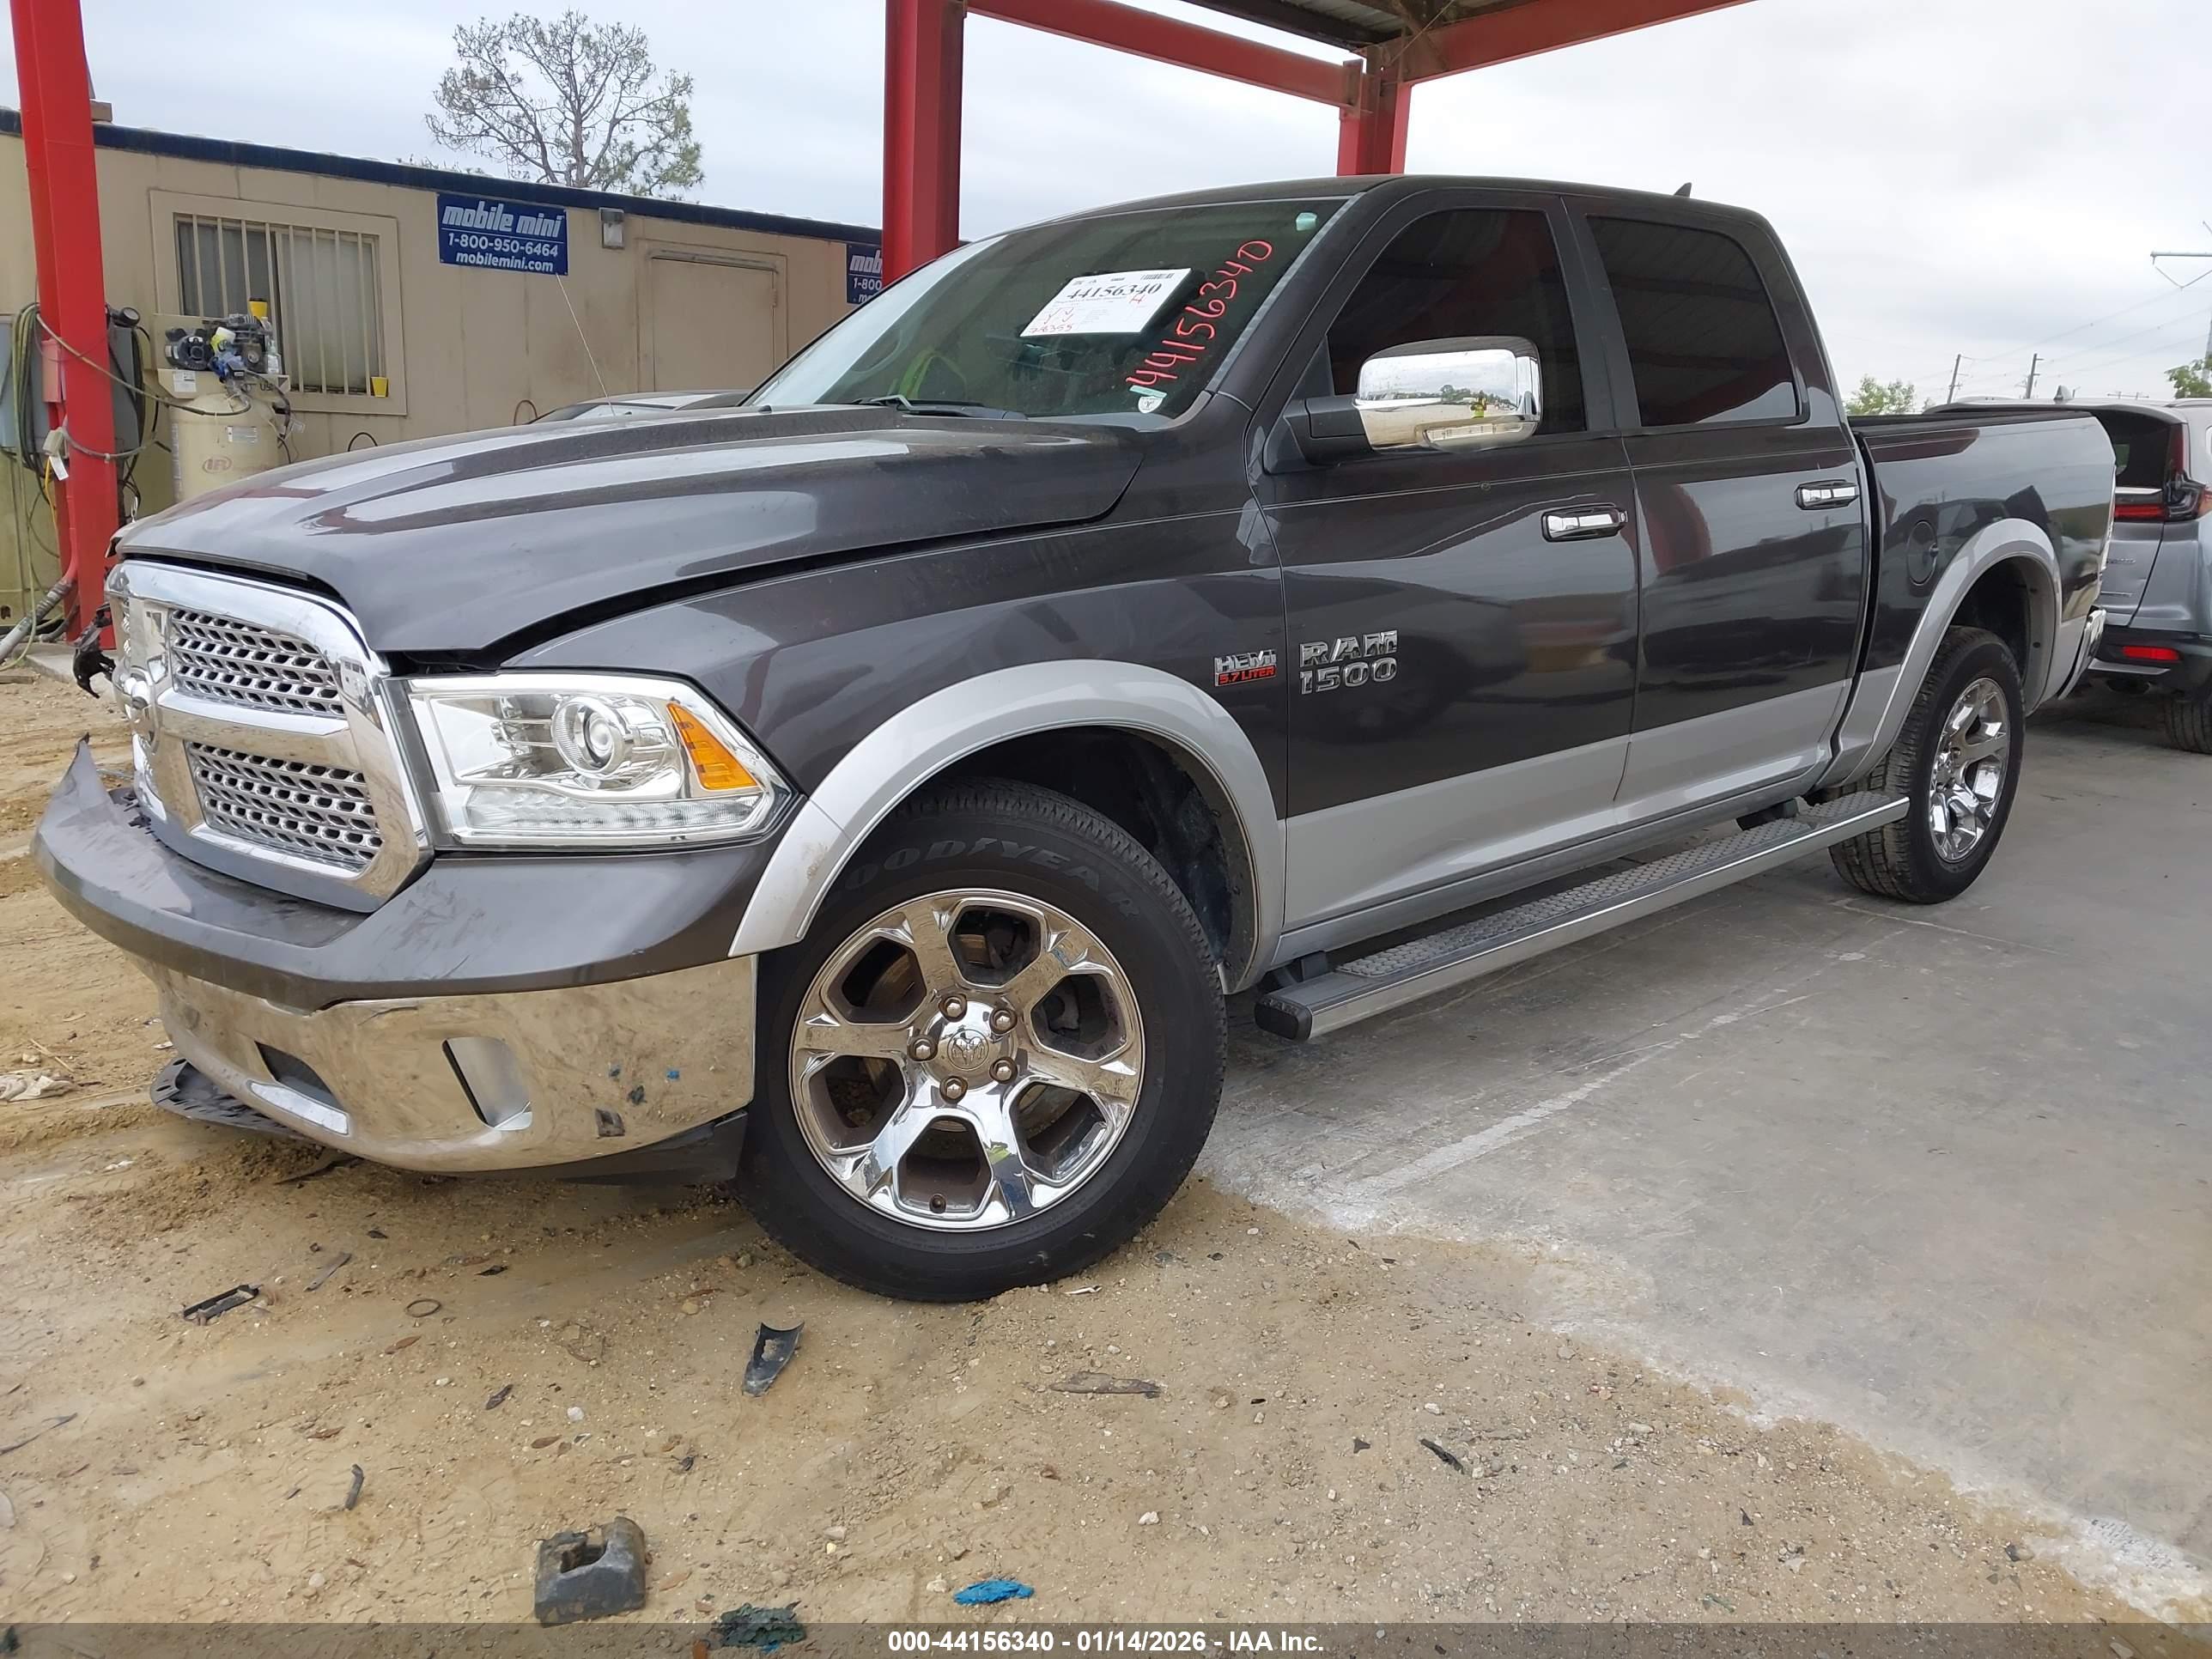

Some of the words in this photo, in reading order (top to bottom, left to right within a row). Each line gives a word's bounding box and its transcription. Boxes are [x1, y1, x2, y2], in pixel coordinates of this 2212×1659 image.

[441, 201, 514, 232] mobile
[516, 213, 564, 238] mini
[447, 233, 558, 258] 1-800-950-6464
[456, 252, 554, 272] mobilemini.com
[1066, 283, 1163, 300] 44156340
[1125, 239, 1273, 387] 44156340
[1214, 649, 1277, 673] HEMI
[1299, 629, 1398, 668] RAM
[1218, 672, 1240, 685] 5.7
[1241, 667, 1275, 682] LITER
[1299, 657, 1398, 695] 1500
